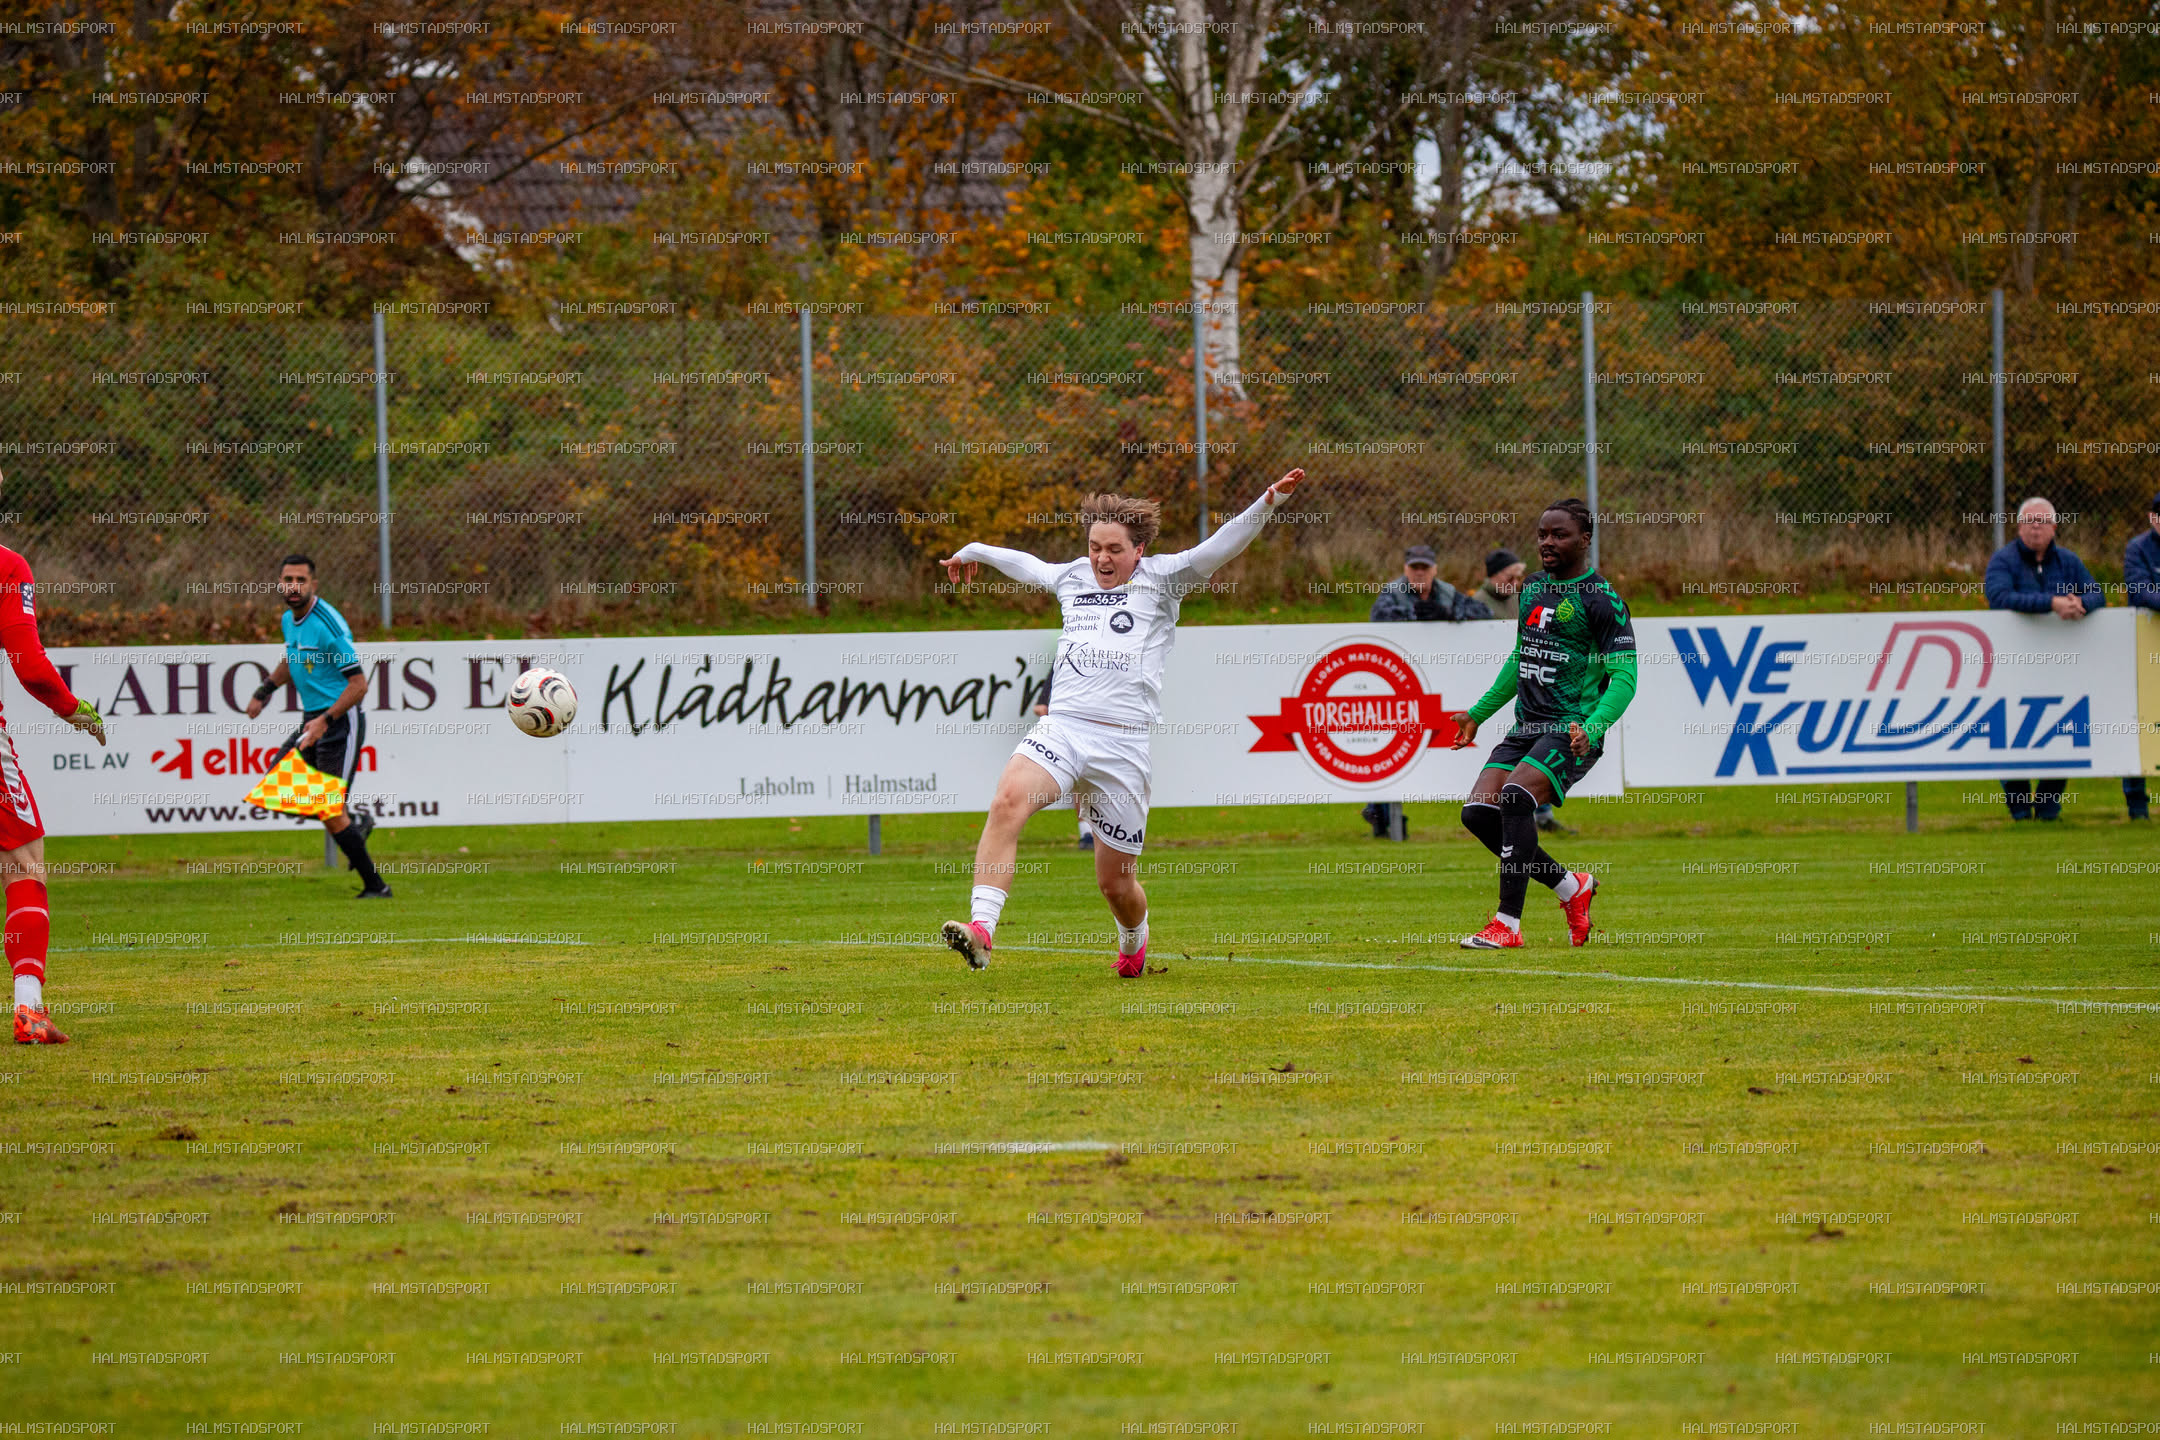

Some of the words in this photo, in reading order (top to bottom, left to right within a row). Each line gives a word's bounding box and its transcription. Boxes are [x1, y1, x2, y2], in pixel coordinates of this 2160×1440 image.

[1526, 605, 1556, 629] AF
[465, 656, 537, 708] E
[1314, 657, 1345, 685] LOKAL
[1302, 699, 1420, 727] TORGHALLEN
[53, 753, 95, 770] DEL
[101, 751, 130, 769] AV
[1372, 758, 1394, 773] OCH
[1543, 748, 1566, 769] 17
[739, 776, 815, 797] Laholm
[845, 772, 937, 793] Halmstad
